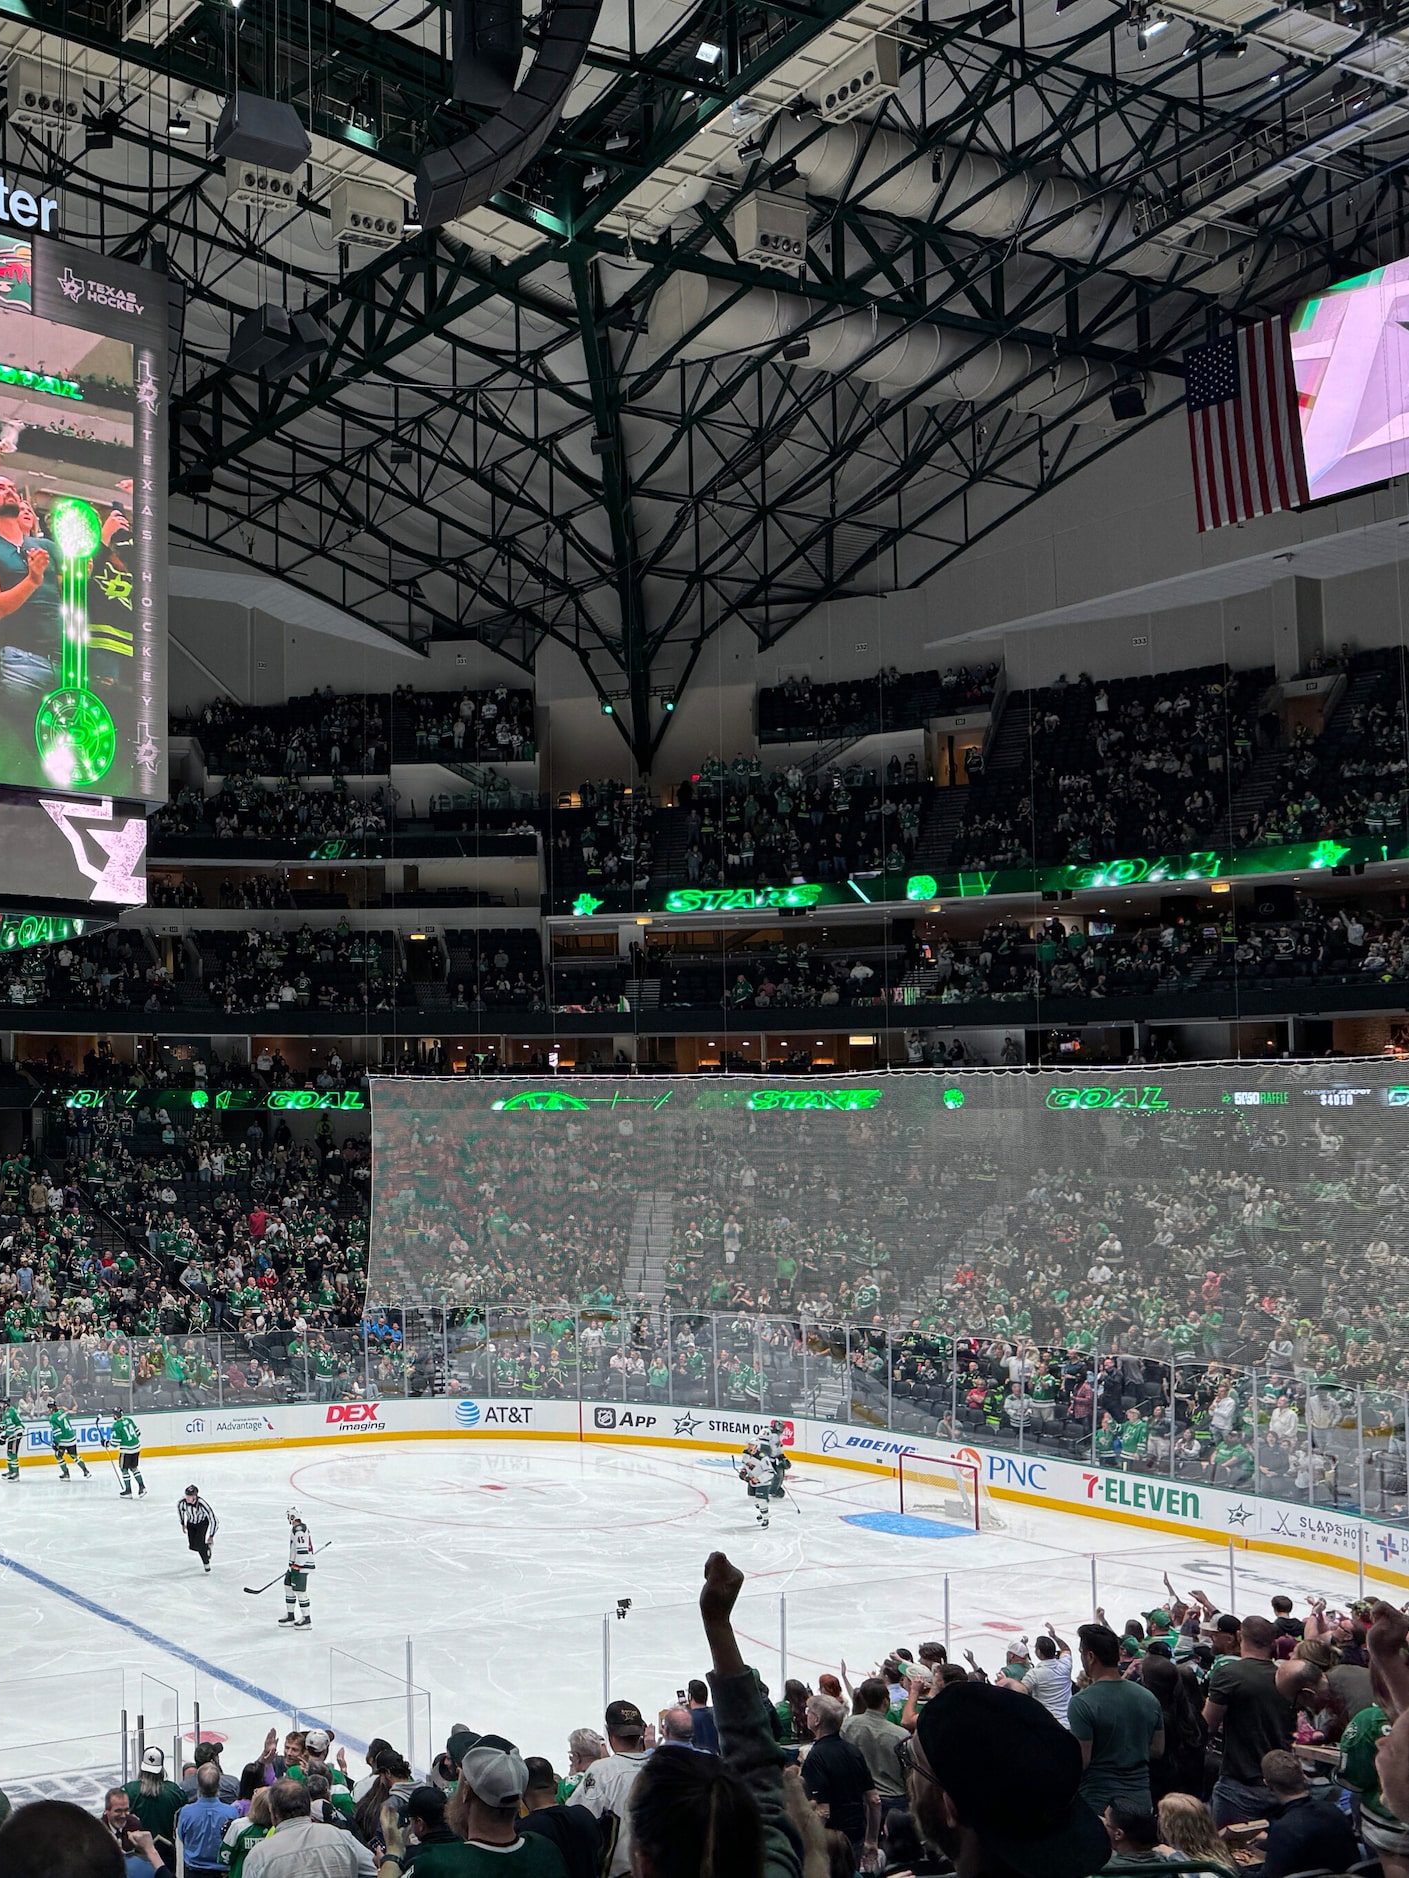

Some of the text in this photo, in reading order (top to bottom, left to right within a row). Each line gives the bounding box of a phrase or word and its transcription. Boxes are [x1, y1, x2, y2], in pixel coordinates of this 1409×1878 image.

[86, 279, 138, 306] TEXAS
[86, 288, 145, 316] HOCKEY
[665, 883, 823, 912] STARS
[267, 1090, 365, 1110] GOAL
[1045, 1086, 1170, 1110] GOAL
[1260, 1091, 1289, 1105] RAFFLE
[325, 1403, 380, 1424] DEX
[484, 1406, 533, 1424] AT&T
[186, 1420, 204, 1433] citi
[216, 1420, 263, 1432] AAdvantage
[338, 1421, 386, 1432] imaging
[708, 1419, 751, 1435] STREAM
[985, 1454, 1048, 1491] PNC
